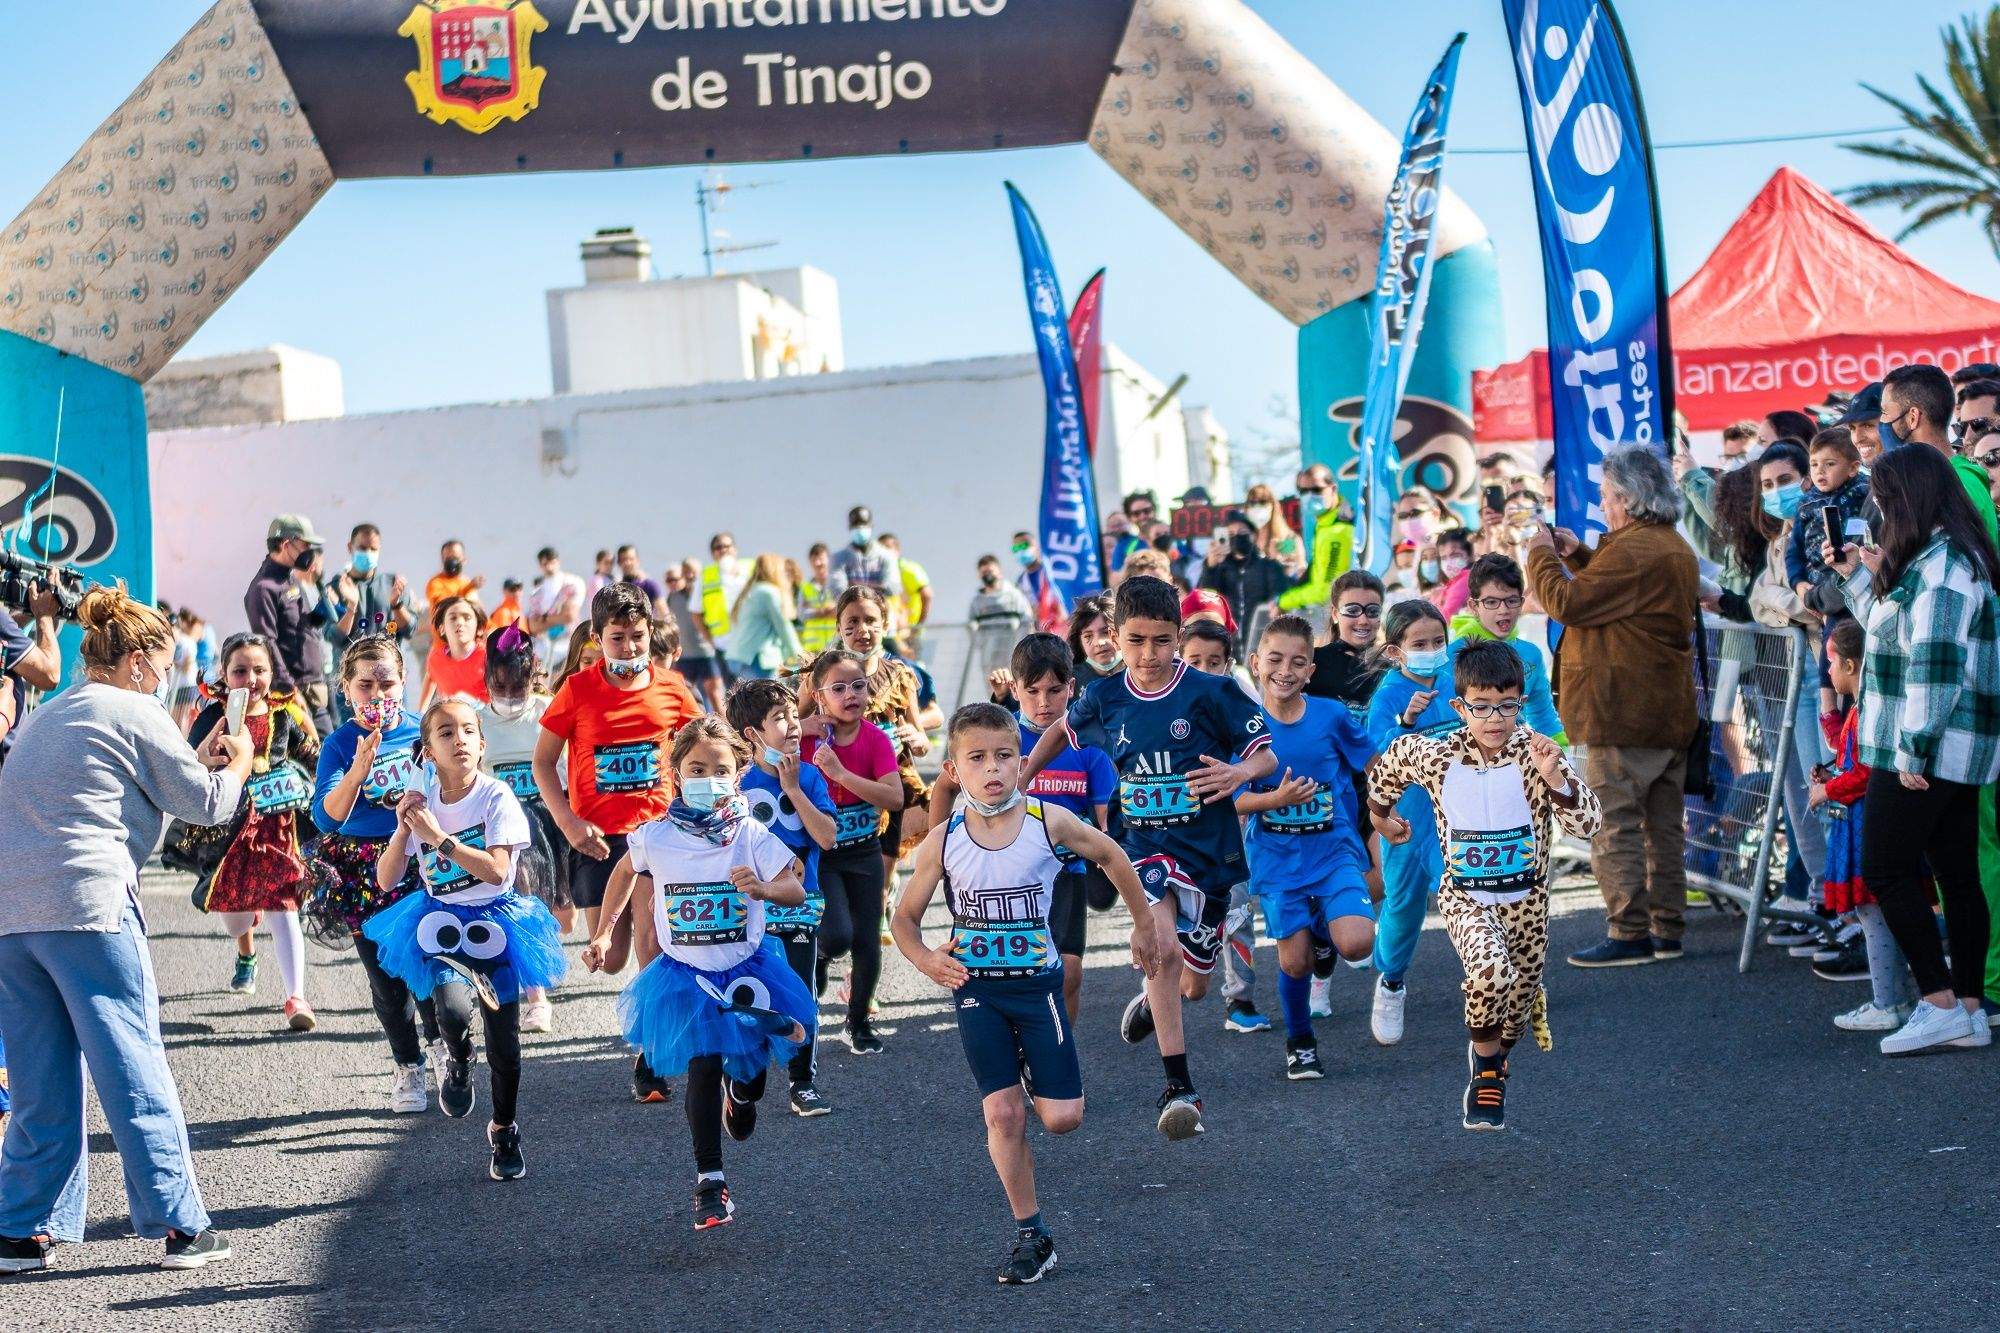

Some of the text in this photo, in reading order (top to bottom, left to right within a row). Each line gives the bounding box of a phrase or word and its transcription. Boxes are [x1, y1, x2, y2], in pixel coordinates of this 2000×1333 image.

[651, 50, 933, 111] de Tinajo
[373, 760, 412, 788] 611
[607, 754, 649, 776] 401
[260, 778, 296, 798] 614
[1038, 779, 1087, 793] TRIDENTE
[1132, 786, 1183, 809] 617
[1465, 843, 1519, 868] 627
[1482, 868, 1505, 876] TIAGO
[679, 896, 731, 923] 621
[965, 917, 1034, 929] Carrera mascaritas
[970, 934, 1030, 958] 619
